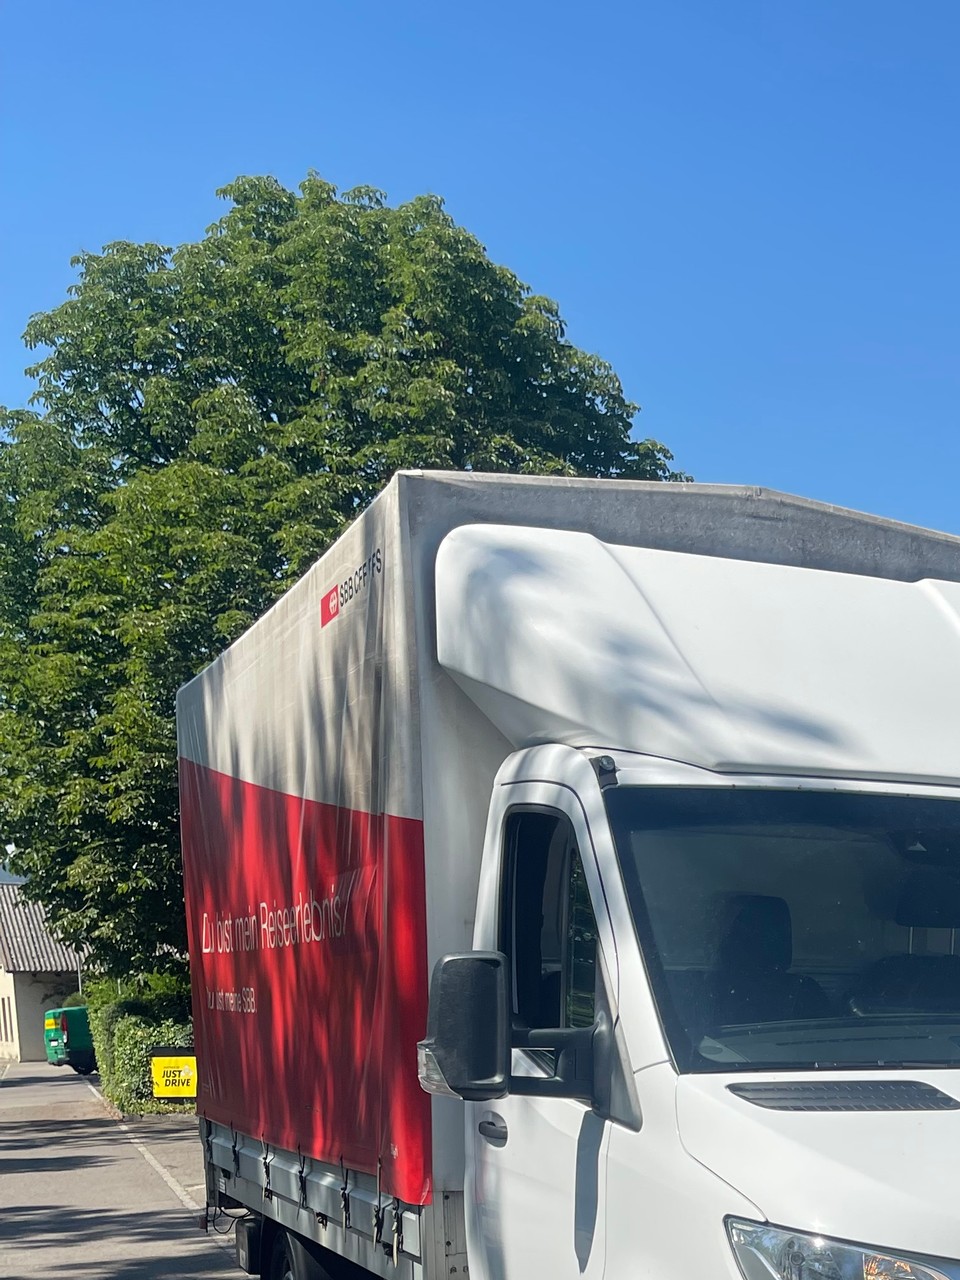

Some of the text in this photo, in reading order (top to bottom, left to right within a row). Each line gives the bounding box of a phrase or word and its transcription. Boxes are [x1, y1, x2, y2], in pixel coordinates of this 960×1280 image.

[340, 576, 353, 607] SBB
[354, 562, 367, 594] CFF
[216, 910, 234, 953] bist
[235, 905, 258, 951] mein
[162, 1069, 182, 1078] JUST
[165, 1079, 191, 1087] DRIVE
